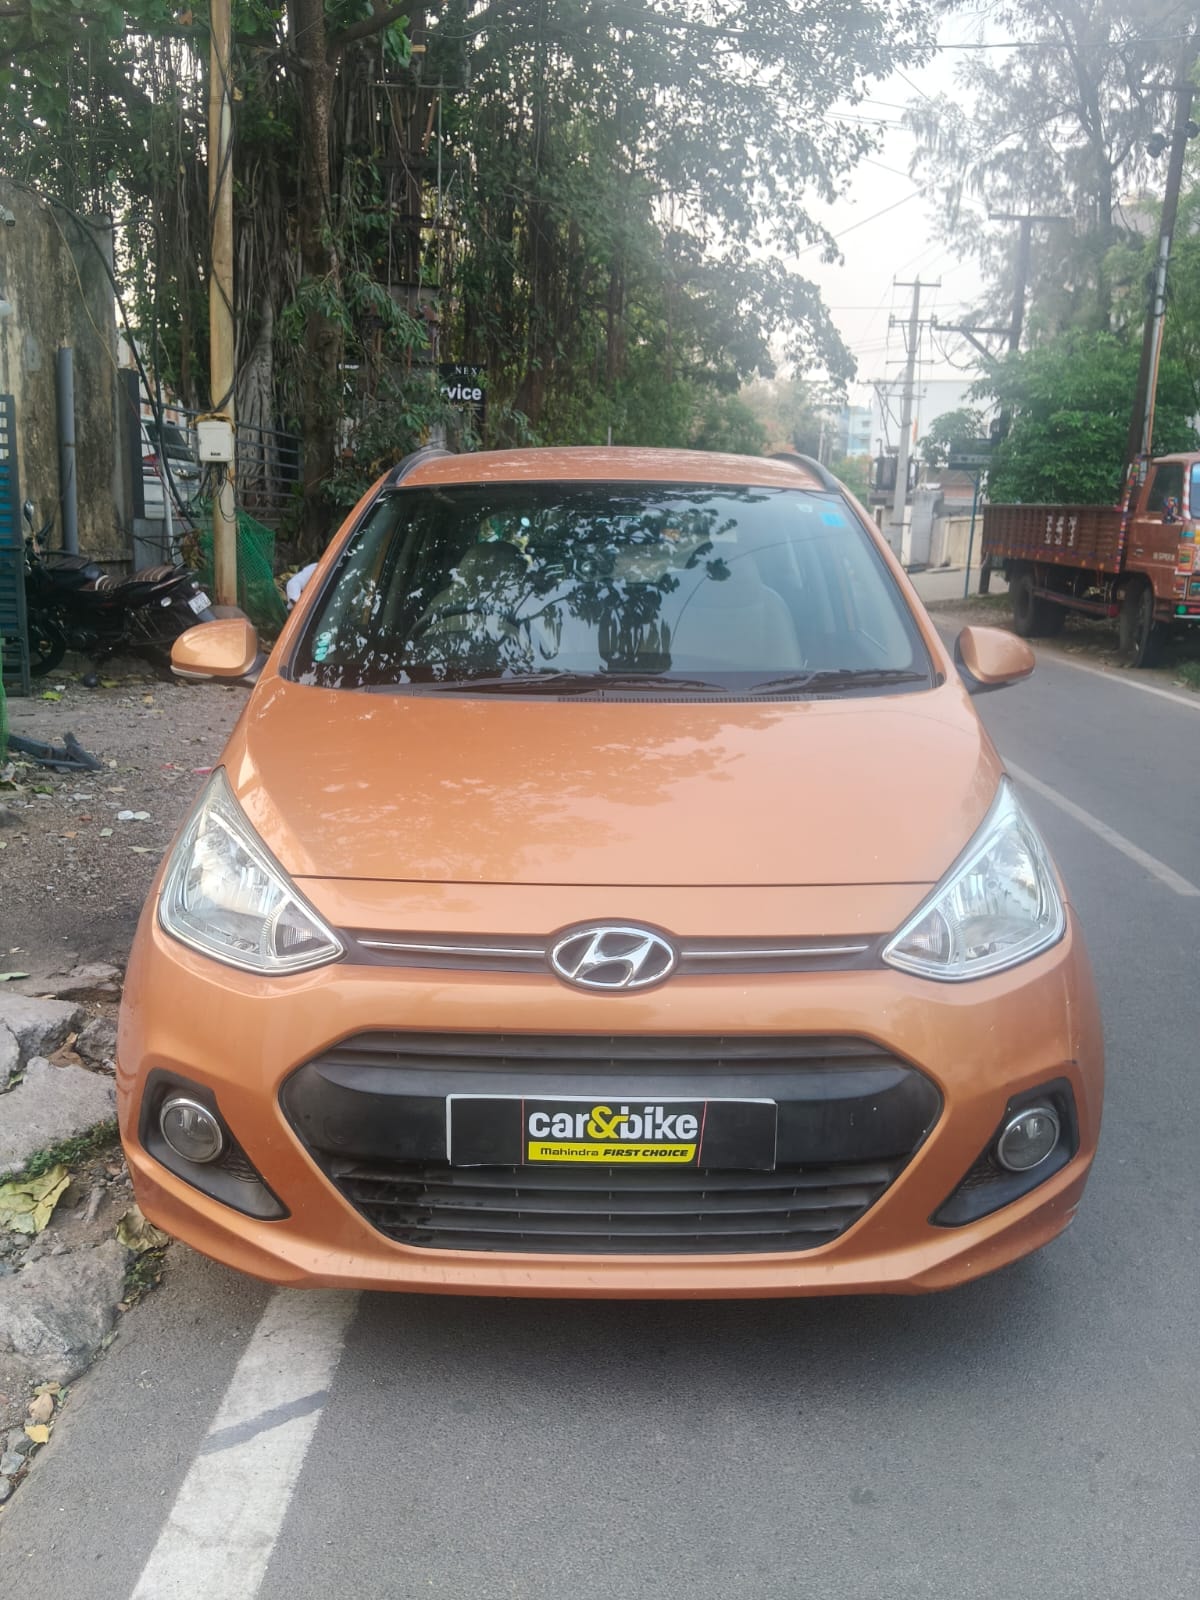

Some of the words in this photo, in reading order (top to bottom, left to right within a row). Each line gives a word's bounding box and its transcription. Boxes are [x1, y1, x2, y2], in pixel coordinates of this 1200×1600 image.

[528, 1105, 699, 1140] car&bike
[540, 1147, 599, 1157] Mahindra
[603, 1149, 642, 1157] FIRST
[642, 1149, 689, 1157] CHOICE
